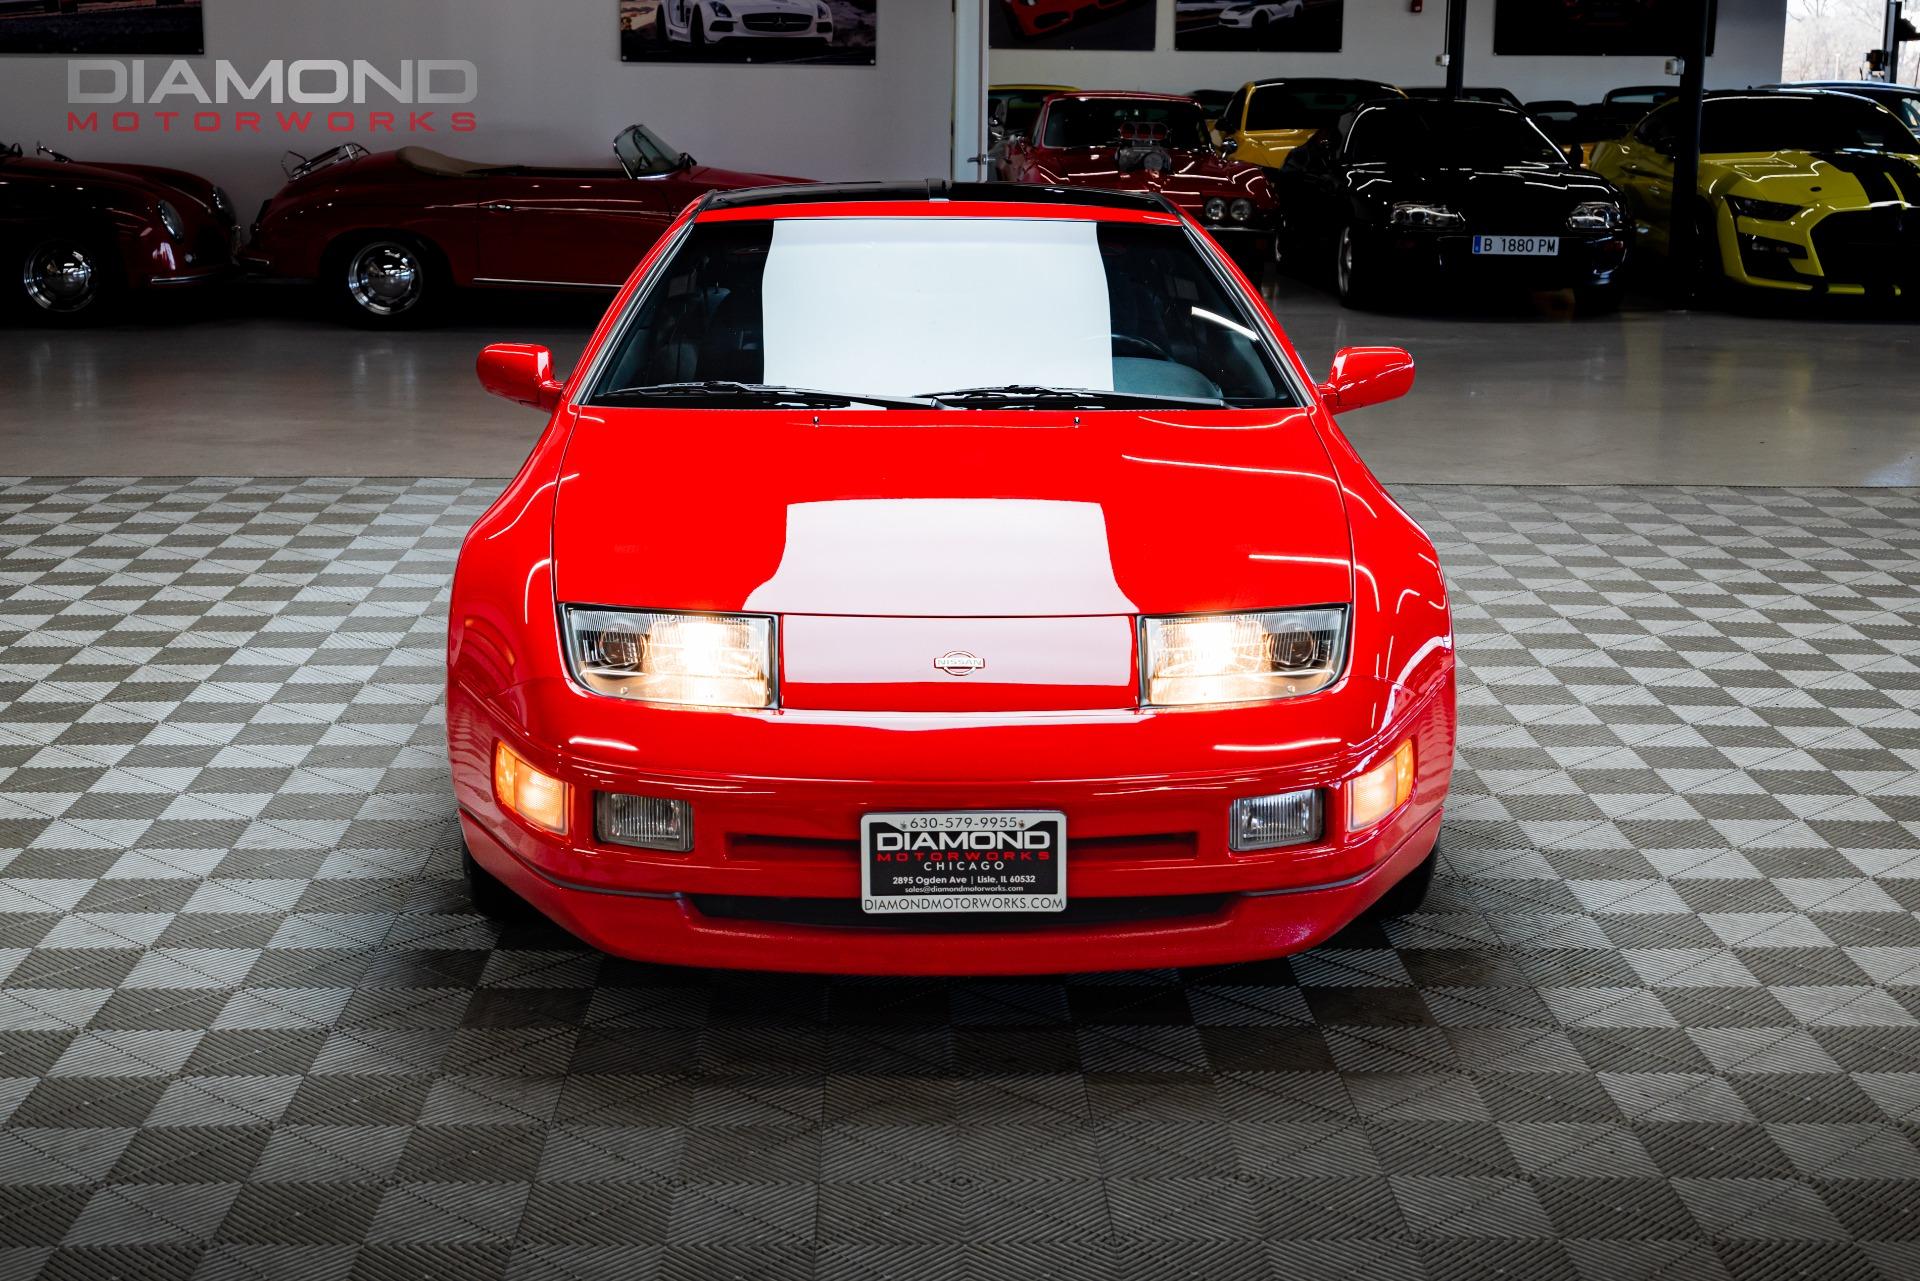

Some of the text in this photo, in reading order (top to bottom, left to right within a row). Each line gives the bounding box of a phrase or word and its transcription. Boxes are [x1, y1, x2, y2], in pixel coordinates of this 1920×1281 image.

[1484, 238, 1493, 251] B
[1502, 238, 1534, 252] 1880
[1538, 239, 1556, 252] PM
[937, 658, 982, 666] NISSAN
[910, 817, 1017, 829] 630-579-9955
[876, 831, 1050, 851] DIAMOND
[876, 851, 1050, 862] MOTORWORKS
[923, 861, 1005, 871] CHICAGO
[892, 876, 914, 885] 2895
[915, 876, 948, 886] Ogden
[949, 876, 967, 884] Ave
[1000, 875, 1008, 883] IL
[1009, 875, 1036, 883] 60532
[904, 885, 1024, 894] sales@diamondmotorworks.com
[864, 897, 1064, 911] DIAMONDMOTORWORKS.COM
